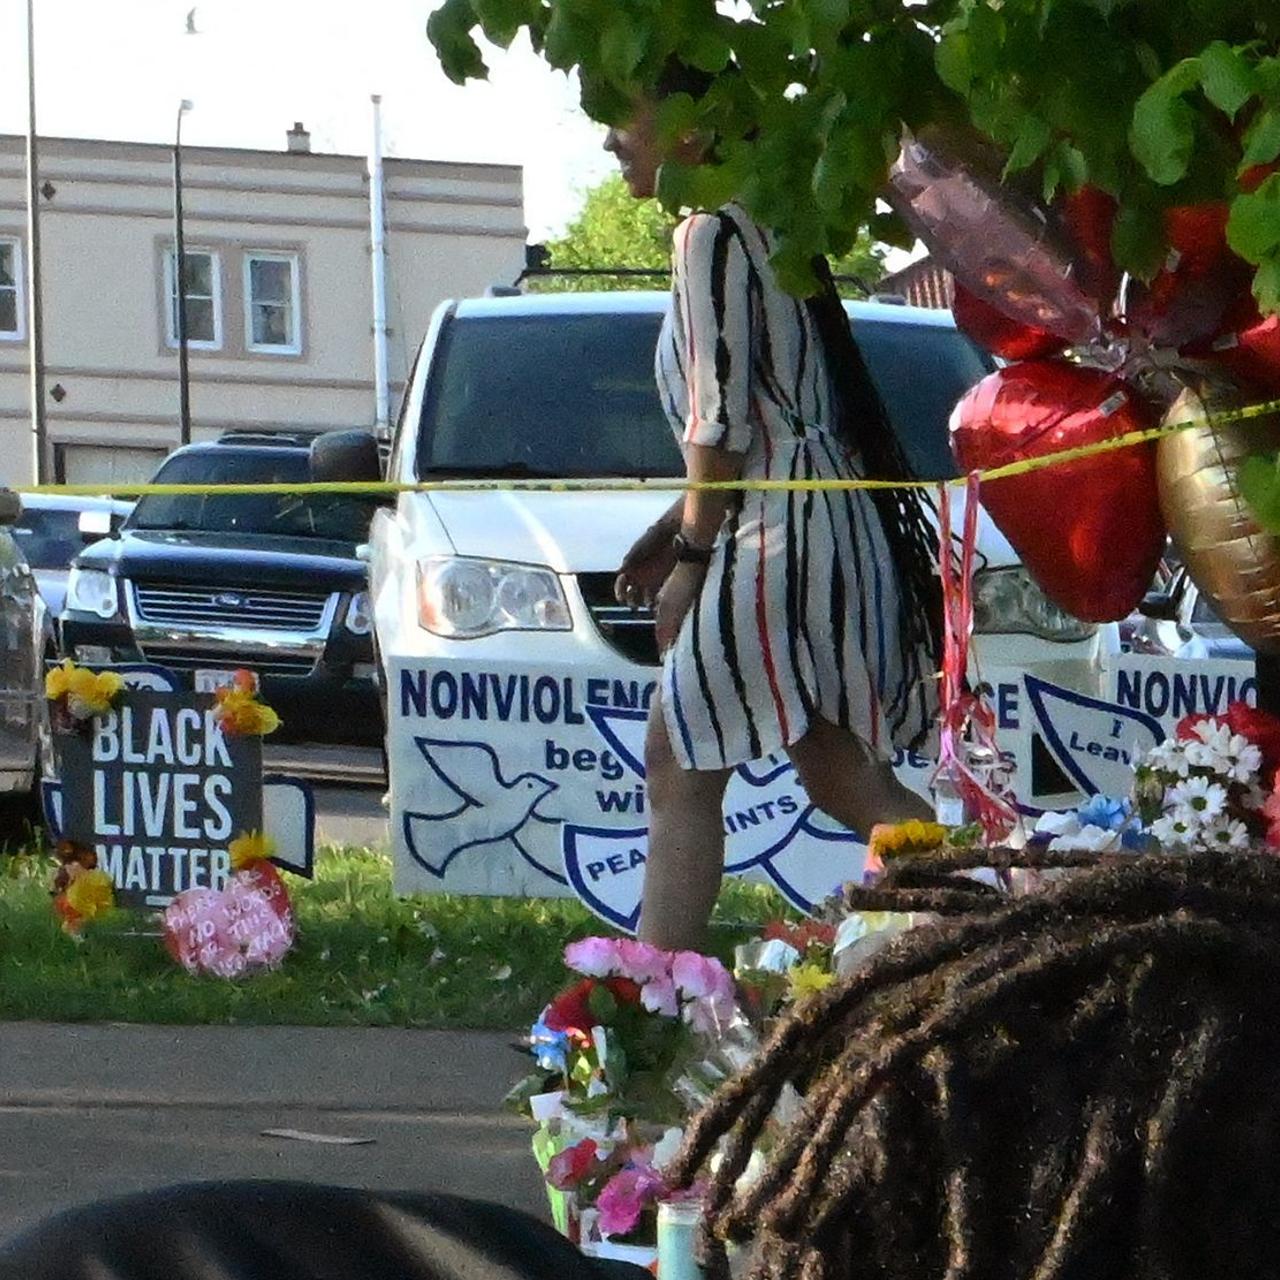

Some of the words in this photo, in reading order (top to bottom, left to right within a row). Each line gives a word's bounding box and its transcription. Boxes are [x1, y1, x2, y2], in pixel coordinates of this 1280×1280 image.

[93, 704, 233, 767] BLACK
[93, 769, 233, 840] LIVES
[95, 844, 232, 892] MATTER
